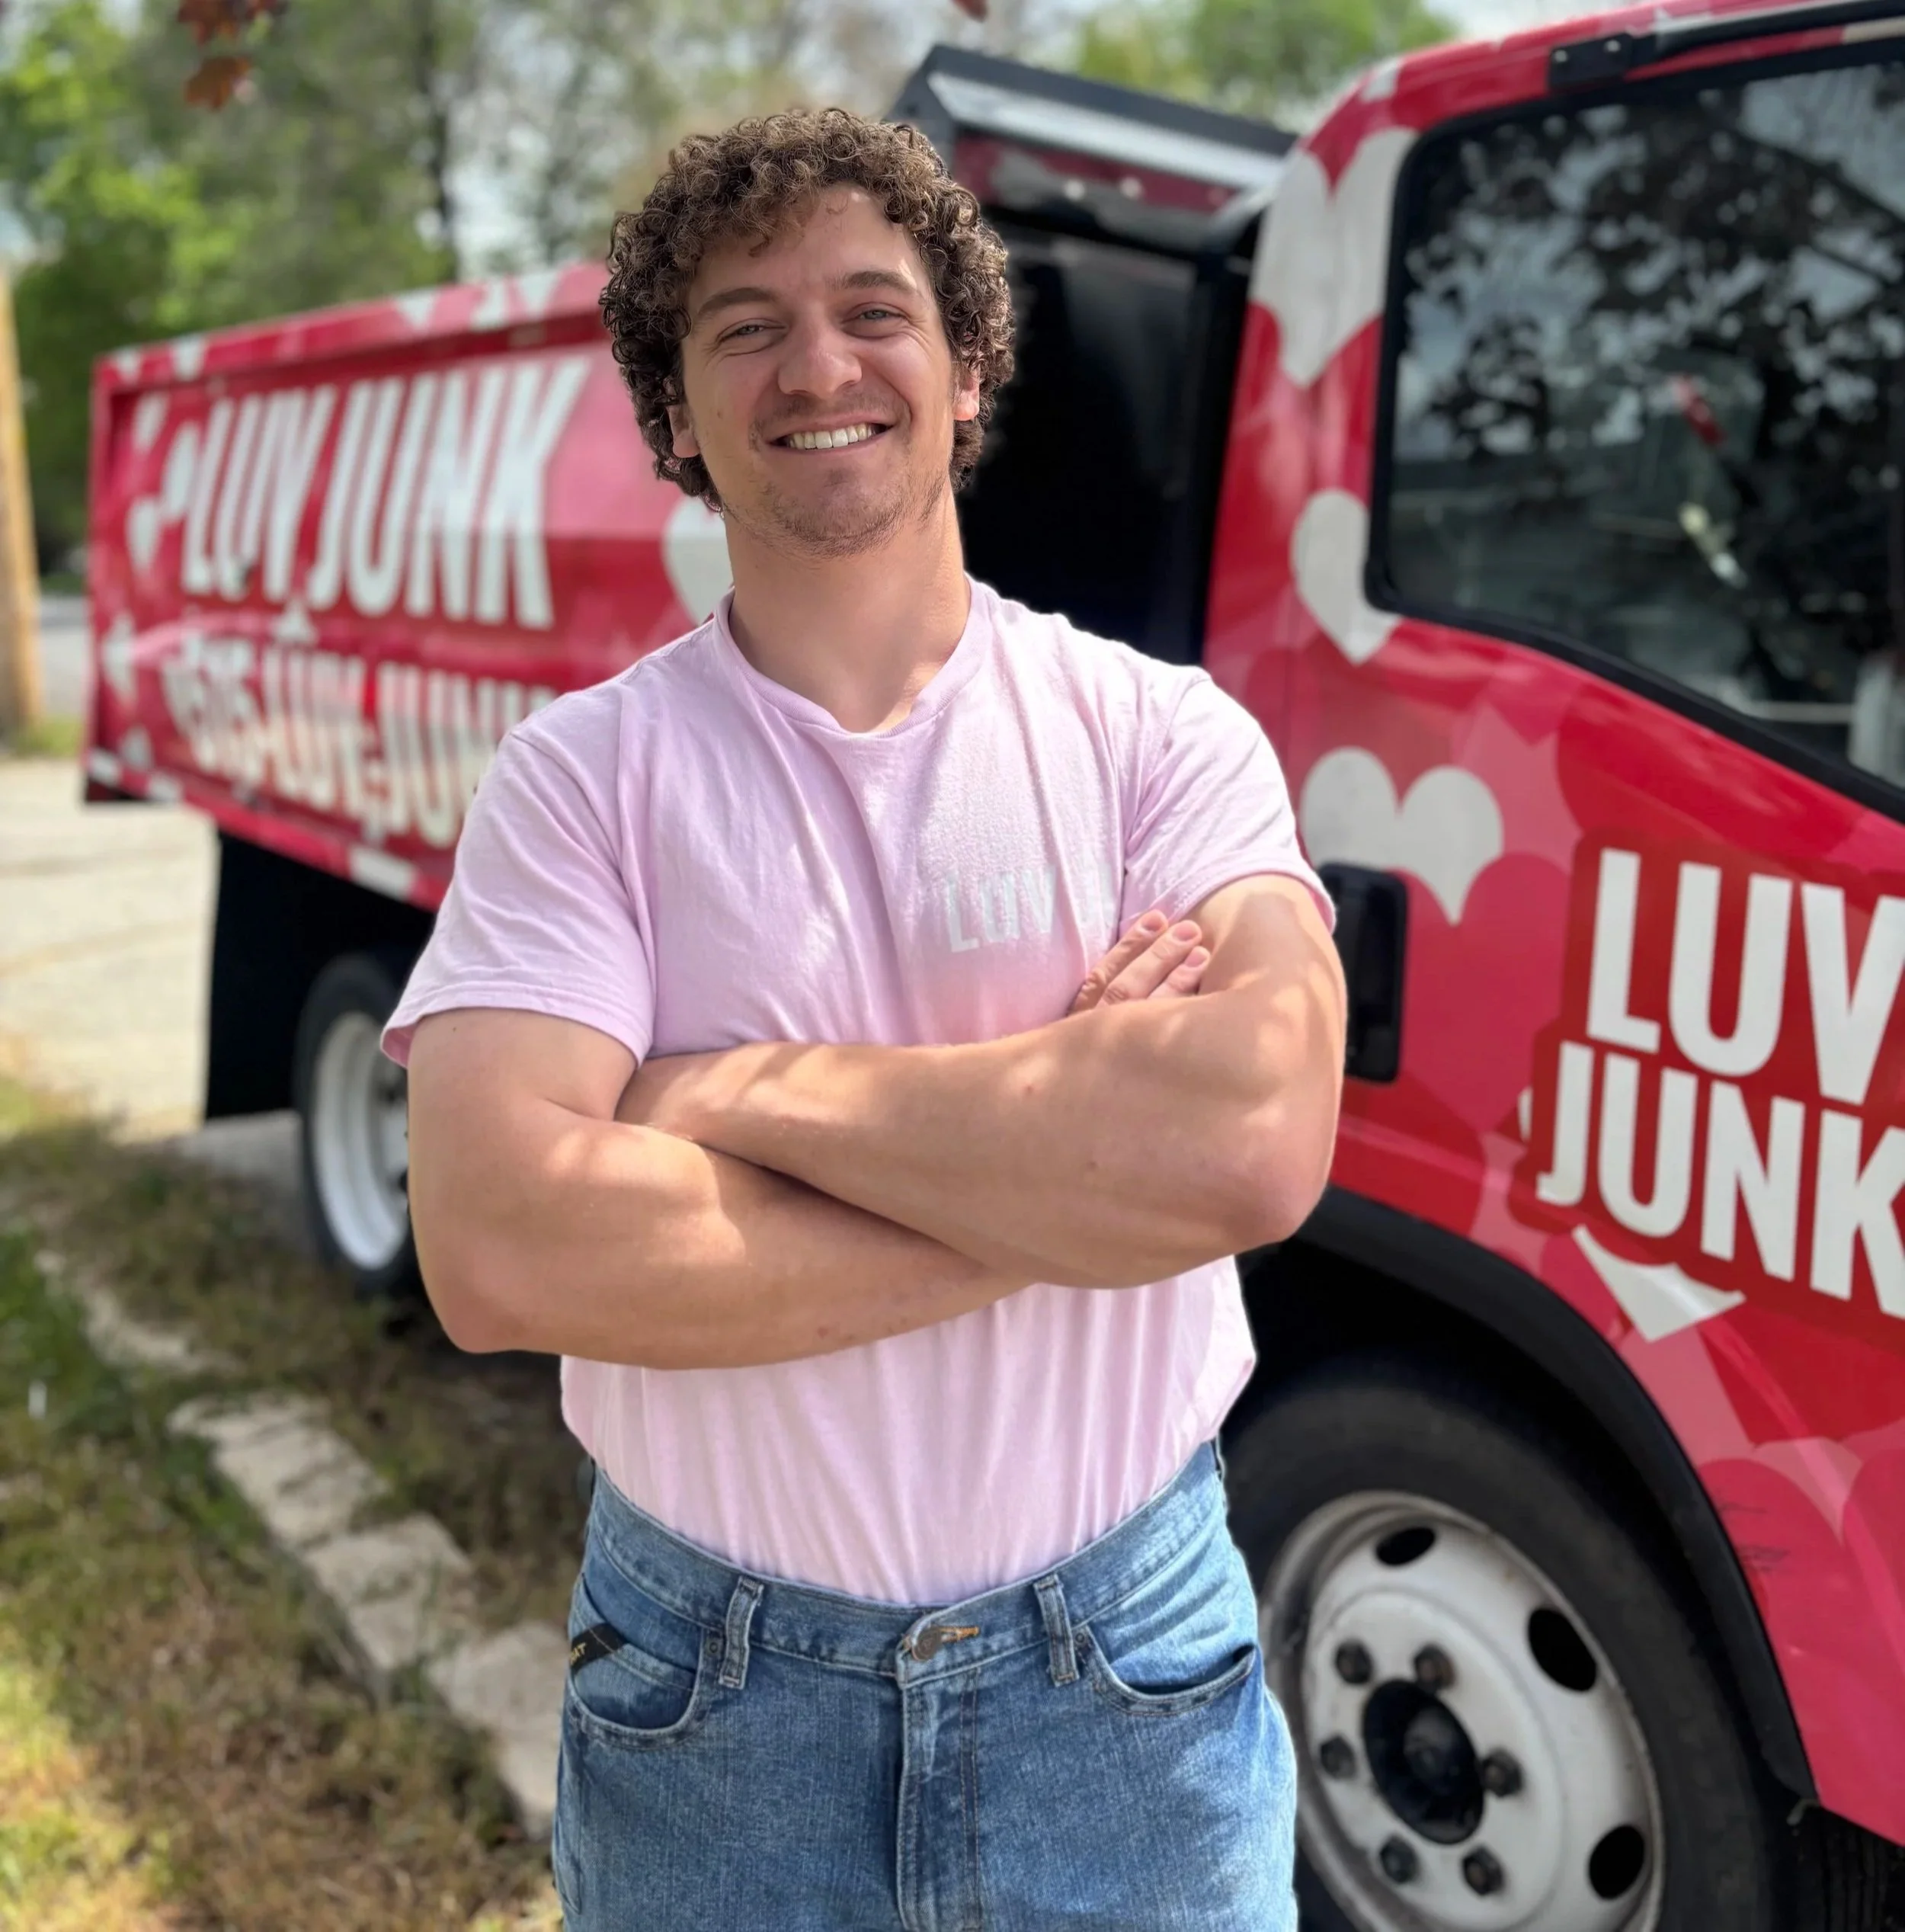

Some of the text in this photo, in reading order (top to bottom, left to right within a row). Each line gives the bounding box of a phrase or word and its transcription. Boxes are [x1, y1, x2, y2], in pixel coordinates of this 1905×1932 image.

[180, 354, 591, 630] LUV JUNK
[946, 867, 1056, 953] LUV
[1586, 847, 1905, 1106] LUV
[1535, 1040, 1905, 1320] JUNK
